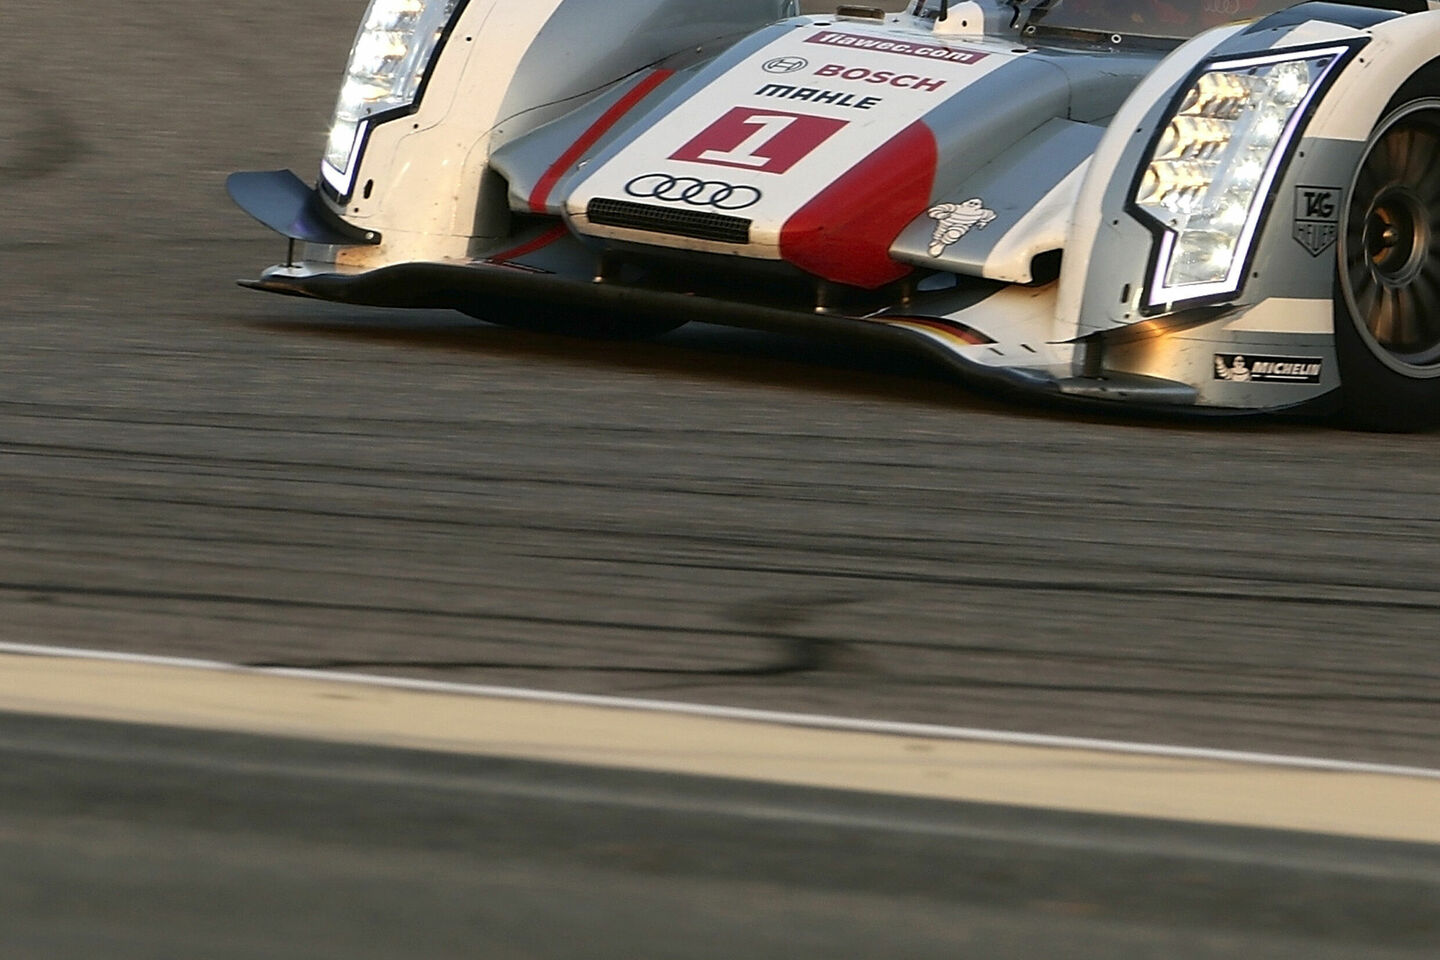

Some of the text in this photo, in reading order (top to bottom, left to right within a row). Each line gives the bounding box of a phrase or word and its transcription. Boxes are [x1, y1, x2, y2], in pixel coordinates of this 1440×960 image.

[821, 33, 973, 61] fiawec.com
[813, 64, 947, 91] BOSCH
[754, 83, 883, 110] MAHLE
[697, 115, 797, 167] 1
[1304, 192, 1335, 218] TAG
[1252, 361, 1321, 376] MICHELIN
